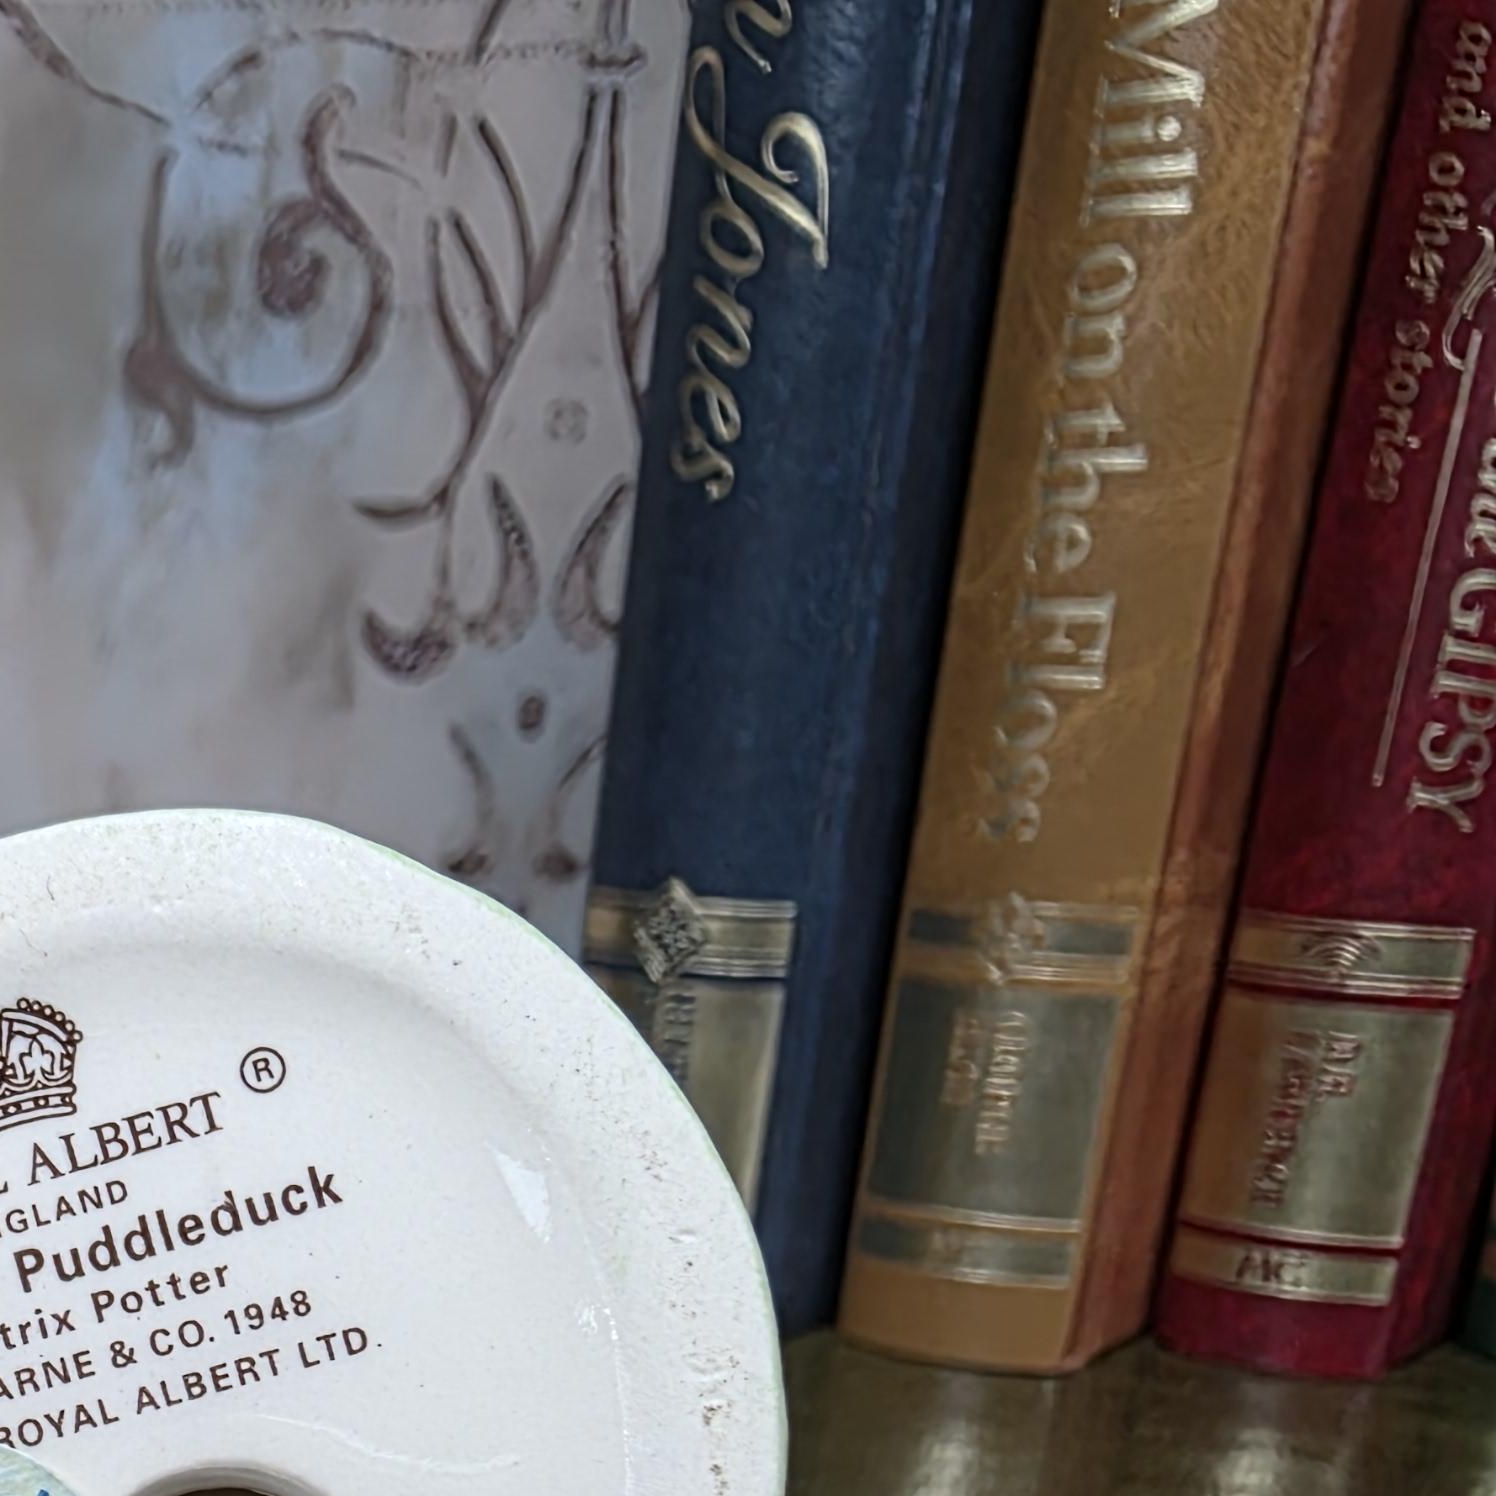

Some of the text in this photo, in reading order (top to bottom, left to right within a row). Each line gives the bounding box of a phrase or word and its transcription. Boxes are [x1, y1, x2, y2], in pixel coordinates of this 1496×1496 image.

[1439, 20, 1492, 133] and
[671, 46, 829, 501] Jones
[1406, 152, 1469, 303] other
[1057, 242, 1137, 388] on
[1365, 319, 1432, 503] stories
[1022, 401, 1148, 573] the
[980, 590, 1117, 843] Floss
[31, 1091, 223, 1185] ALBERT
[13, 1166, 343, 1293] Puddleduck
[90, 1265, 228, 1324] Potter
[109, 1340, 138, 1369] &
[149, 1319, 215, 1356] CO.
[223, 1290, 312, 1335] 1948
[136, 1348, 280, 1415] ALBERT
[297, 1327, 383, 1369] LTD.
